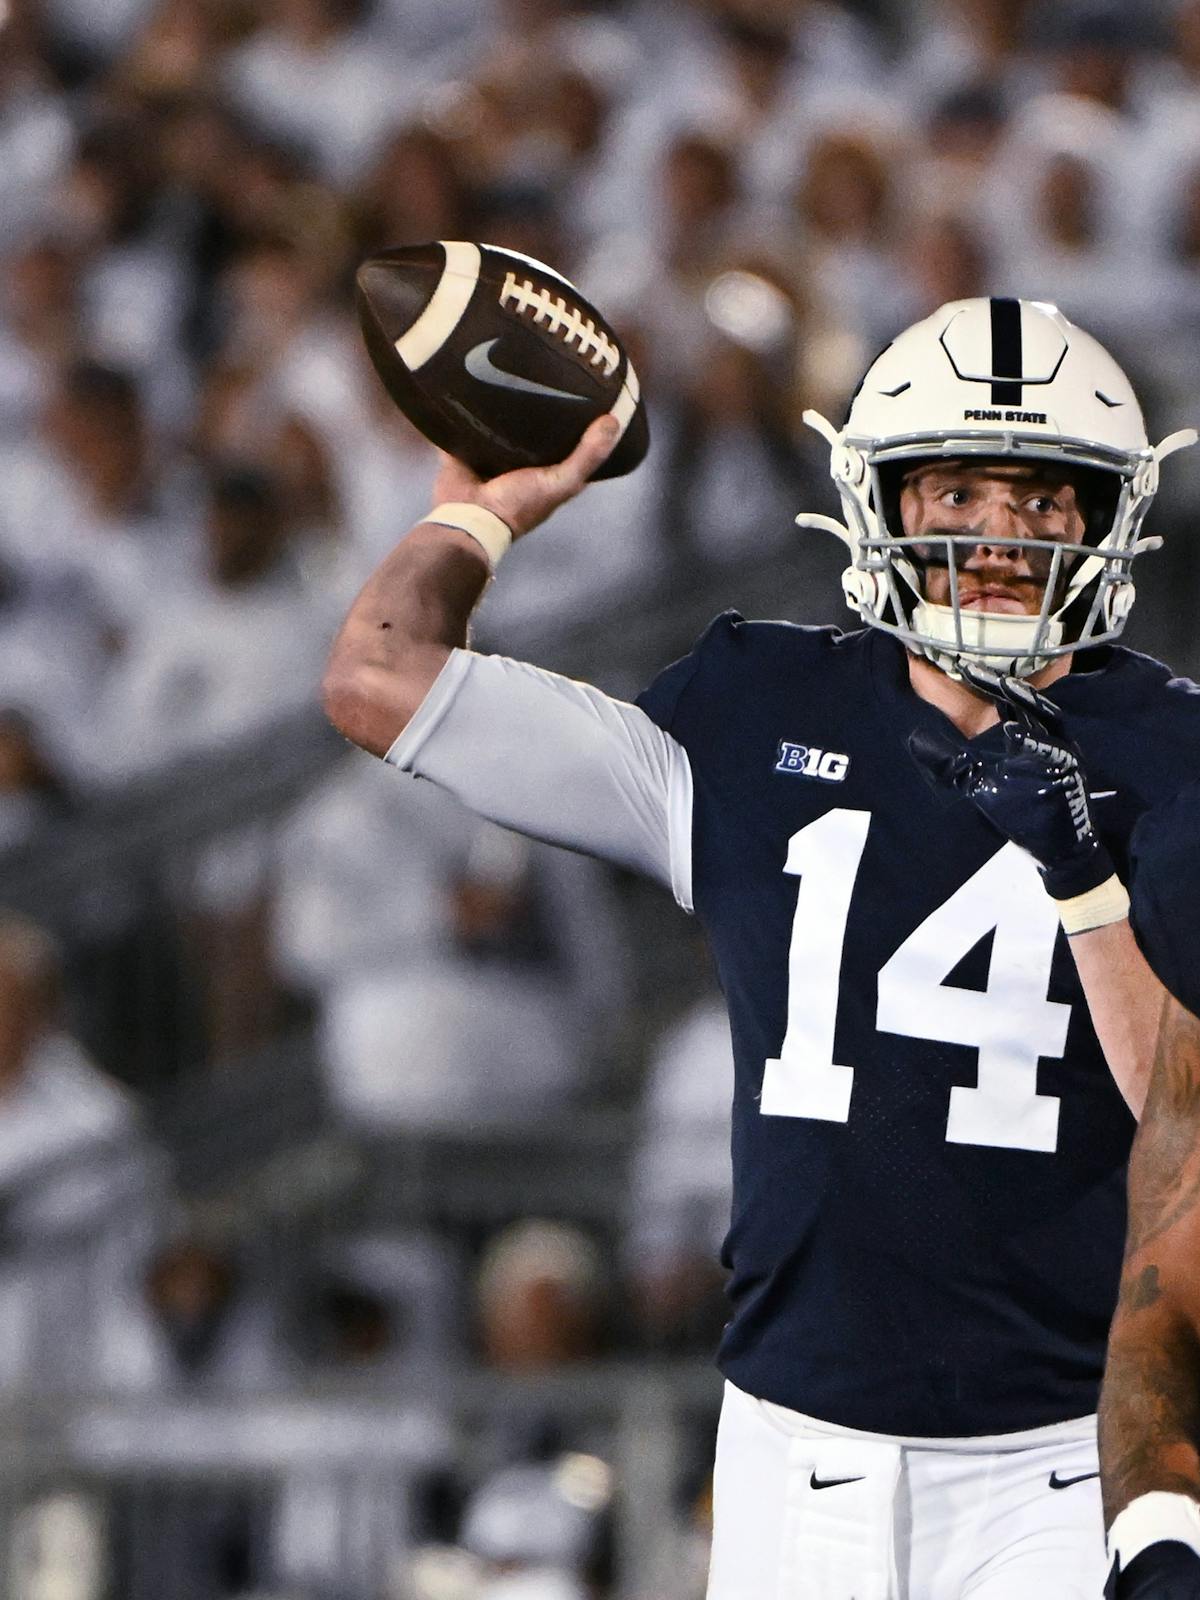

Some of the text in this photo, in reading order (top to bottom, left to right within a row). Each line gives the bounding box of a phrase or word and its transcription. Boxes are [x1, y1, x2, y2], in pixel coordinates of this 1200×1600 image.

[964, 409, 1047, 424] PENN STATE
[759, 807, 1072, 1153] 14
